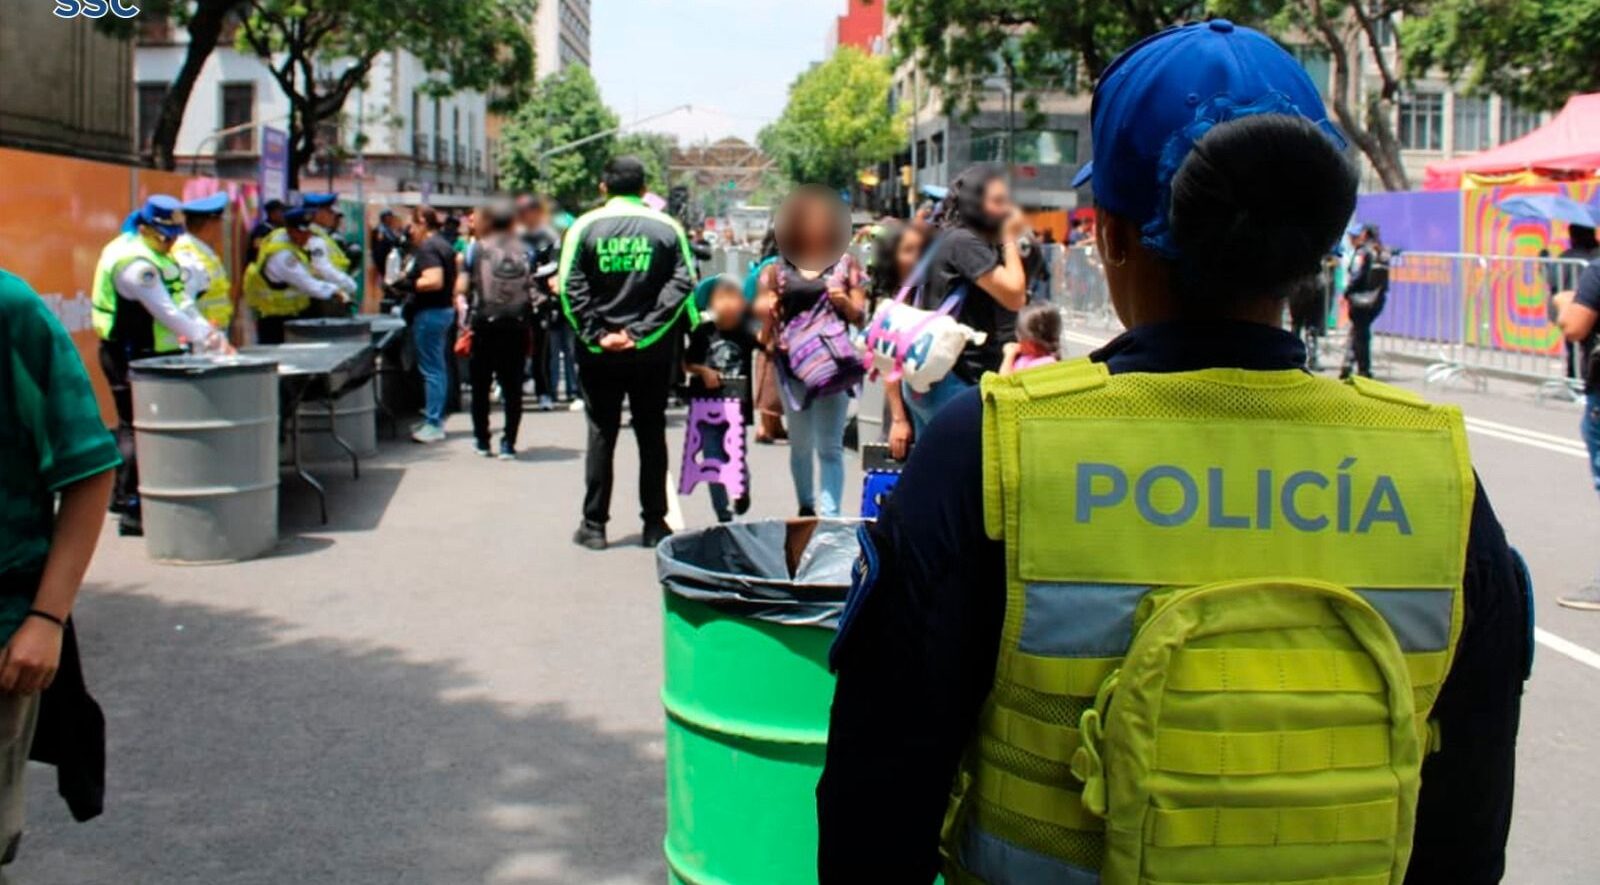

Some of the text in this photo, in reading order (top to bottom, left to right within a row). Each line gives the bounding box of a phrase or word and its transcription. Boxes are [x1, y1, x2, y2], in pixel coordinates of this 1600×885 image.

[596, 235, 653, 254] LOCAL
[599, 254, 651, 273] CREW
[1075, 457, 1412, 535] POLICÍA
